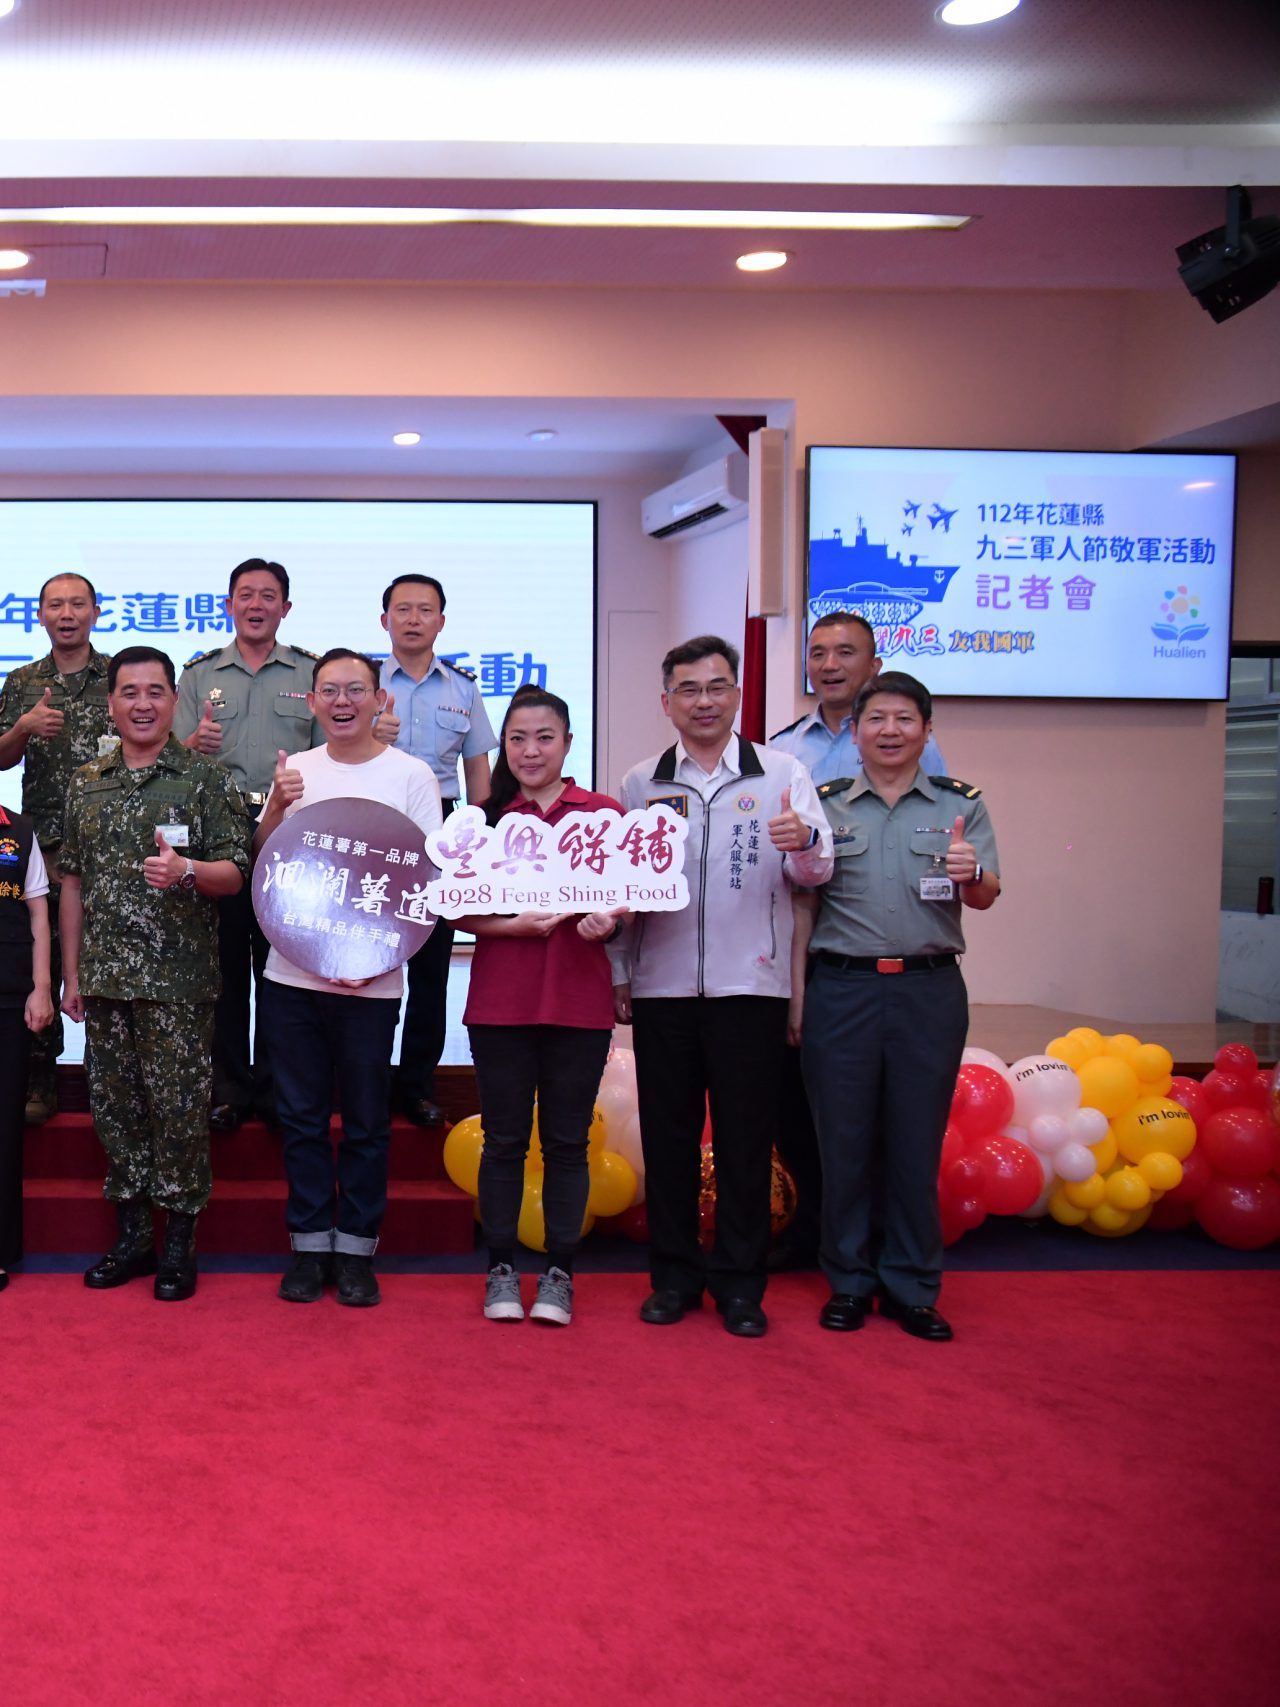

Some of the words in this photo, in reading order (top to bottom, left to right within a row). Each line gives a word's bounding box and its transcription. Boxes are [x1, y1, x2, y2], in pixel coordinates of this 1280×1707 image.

[977, 502, 1105, 527] 112年花蓮縣
[976, 534, 1217, 565] 九三軍人節敬軍活動
[976, 573, 1097, 611] 記者會
[1153, 645, 1207, 658] Hualien
[302, 830, 420, 867] 花蓮薯第一品牌
[729, 824, 743, 890] 軍人服務站
[746, 819, 761, 866] 花蓮縣
[438, 883, 492, 908] 1928
[501, 886, 551, 906] Feng
[559, 885, 617, 905] Shing
[625, 883, 677, 901] Food
